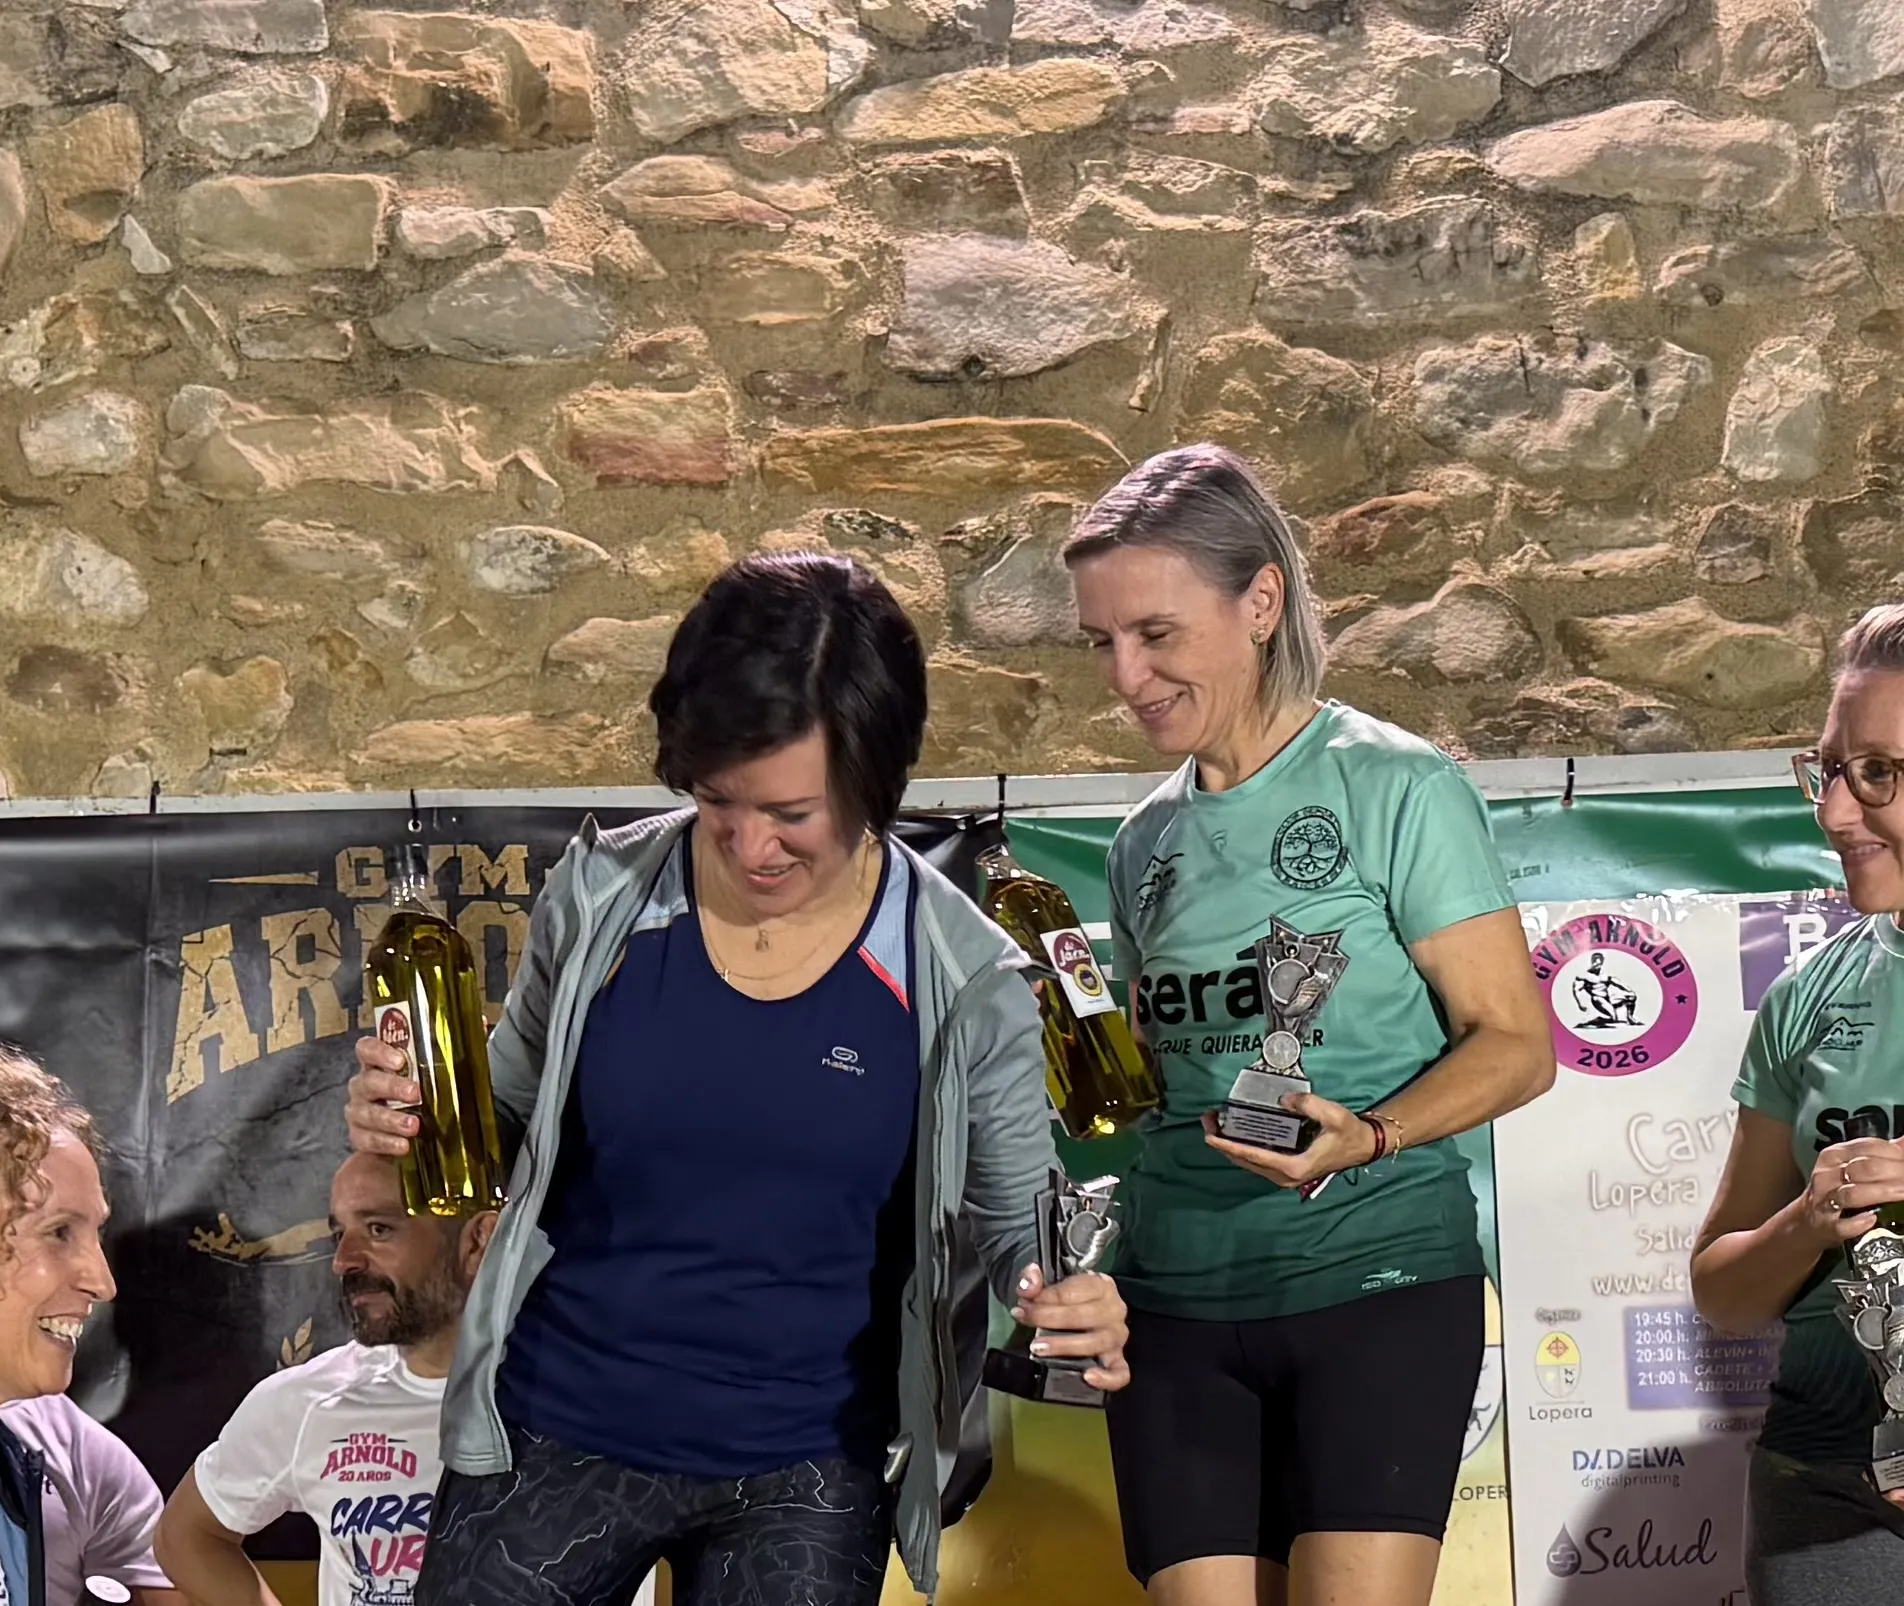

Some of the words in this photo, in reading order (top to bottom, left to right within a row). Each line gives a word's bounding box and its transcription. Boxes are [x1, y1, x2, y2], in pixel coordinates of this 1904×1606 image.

[1136, 936, 1265, 1026] será
[1201, 1031, 1264, 1055] QUIERA
[1577, 1045, 1650, 1070] 2026
[1627, 1109, 1739, 1175] Carr
[1589, 1168, 1700, 1218] Lopera
[1635, 1222, 1696, 1257] Salid
[1591, 1262, 1689, 1297] www.de
[1634, 1311, 1672, 1327] 19:45
[1636, 1347, 1674, 1363] 20:30
[1638, 1370, 1676, 1386] 21:00
[1528, 1405, 1593, 1423] Lopera
[319, 1445, 418, 1480] ARNOLD
[1454, 1484, 1508, 1501] OPER
[330, 1492, 434, 1538] CARR
[370, 1534, 427, 1577] UR
[1579, 1518, 1718, 1575] Salud
